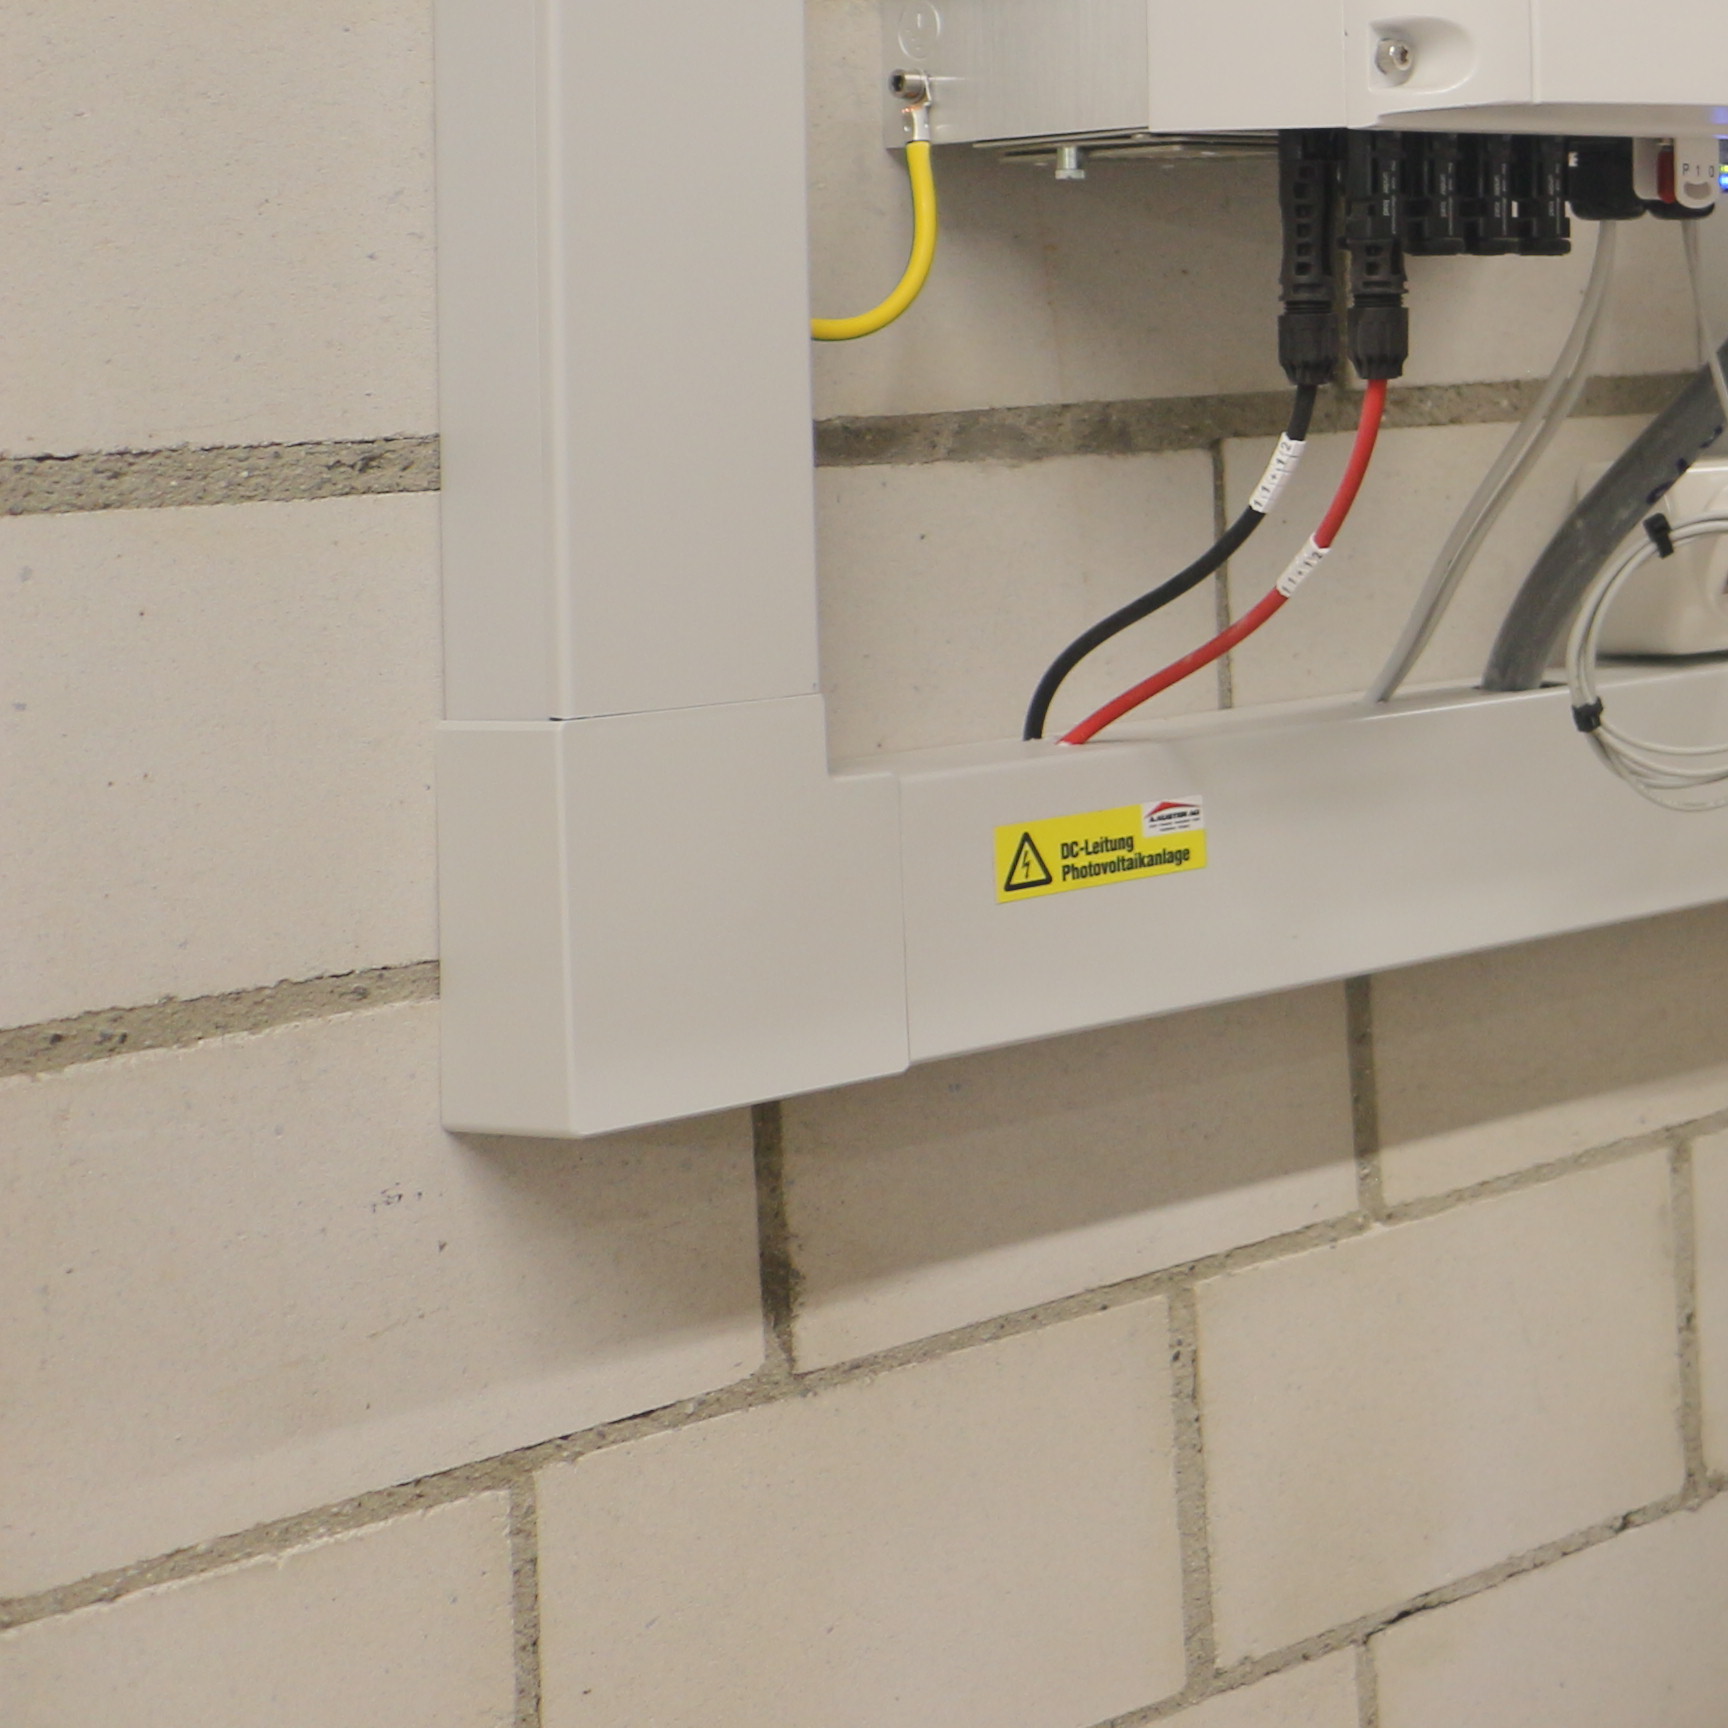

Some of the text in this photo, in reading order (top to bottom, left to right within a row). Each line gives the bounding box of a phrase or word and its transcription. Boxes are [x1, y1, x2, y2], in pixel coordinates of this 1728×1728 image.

[1682, 163, 1689, 176] P
[1060, 835, 1134, 860] DC-Leitung
[1061, 847, 1190, 882] Photovoltaikanlage
